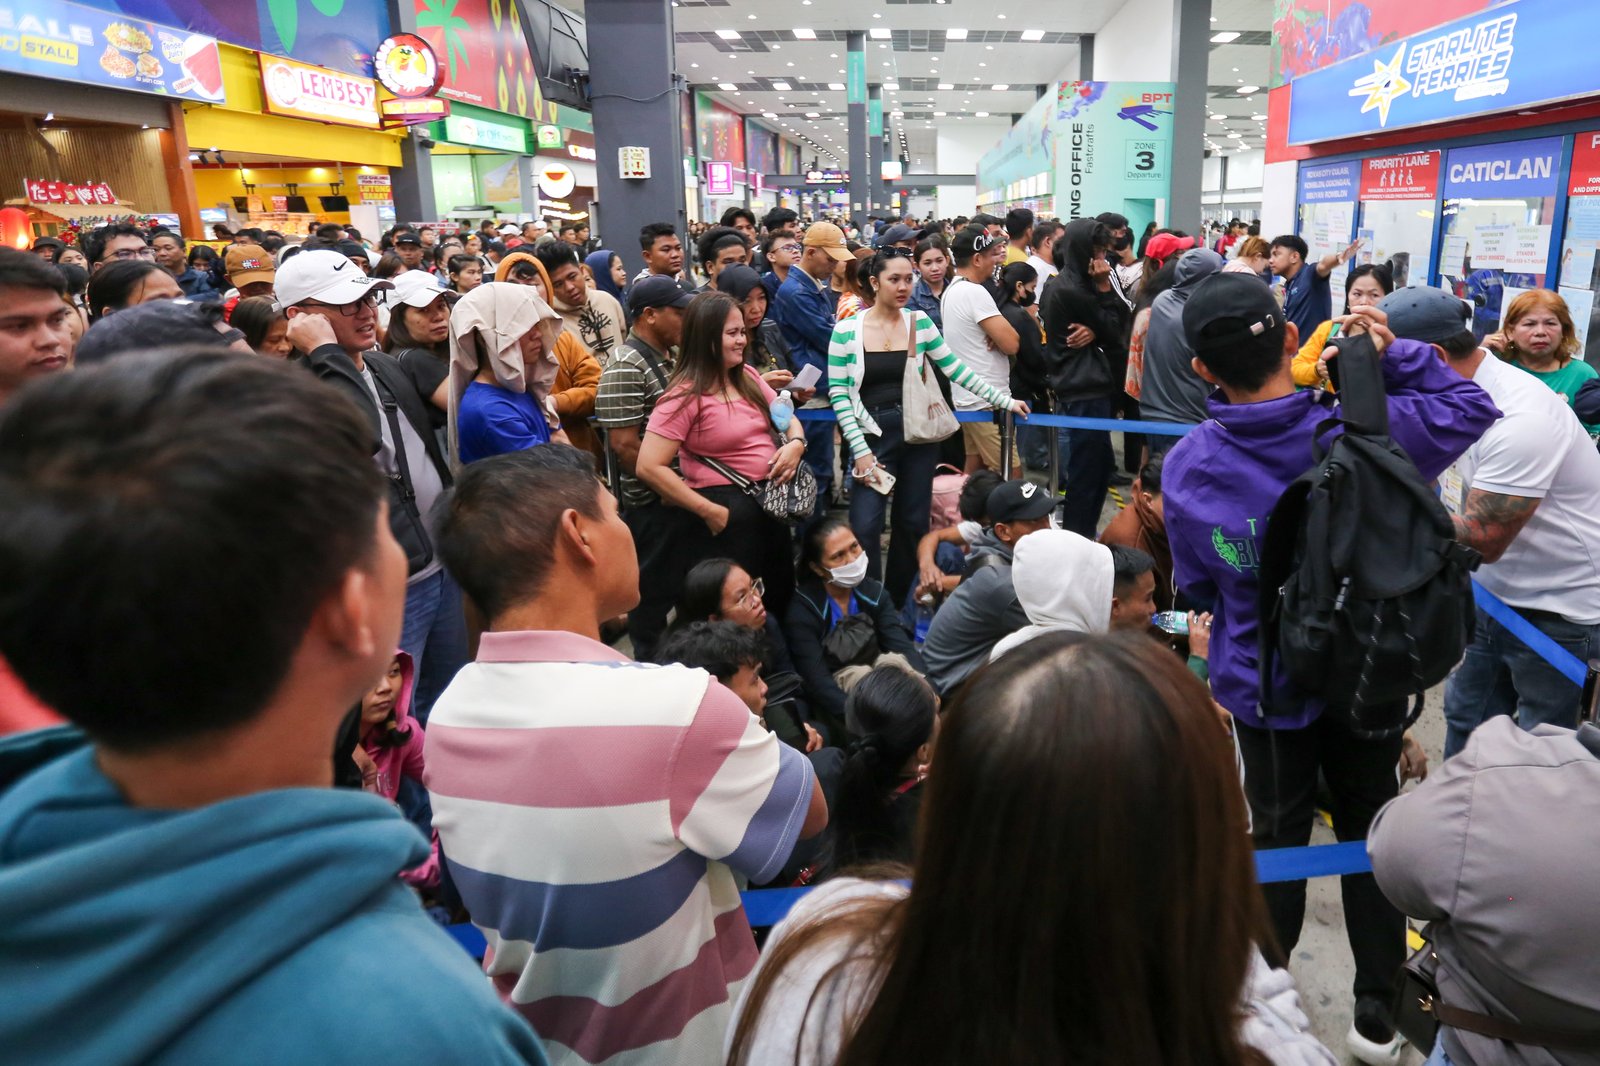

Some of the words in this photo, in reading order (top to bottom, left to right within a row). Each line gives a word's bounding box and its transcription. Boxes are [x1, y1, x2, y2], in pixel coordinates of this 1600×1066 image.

[25, 41, 75, 60] STALL
[1406, 13, 1517, 74] STARLITE
[1412, 45, 1514, 98] FERRIES
[300, 71, 374, 107] LEMBEST
[1142, 93, 1172, 103] BPT
[1071, 123, 1083, 186] OFFICE
[1084, 124, 1095, 174] Fastcrafts
[1134, 142, 1157, 150] ZONE
[1135, 151, 1155, 171] 3
[1369, 156, 1405, 170] PRIORITY
[1406, 154, 1430, 167] LANE
[1450, 156, 1552, 183] CATICLAN
[1127, 171, 1162, 179] Departure
